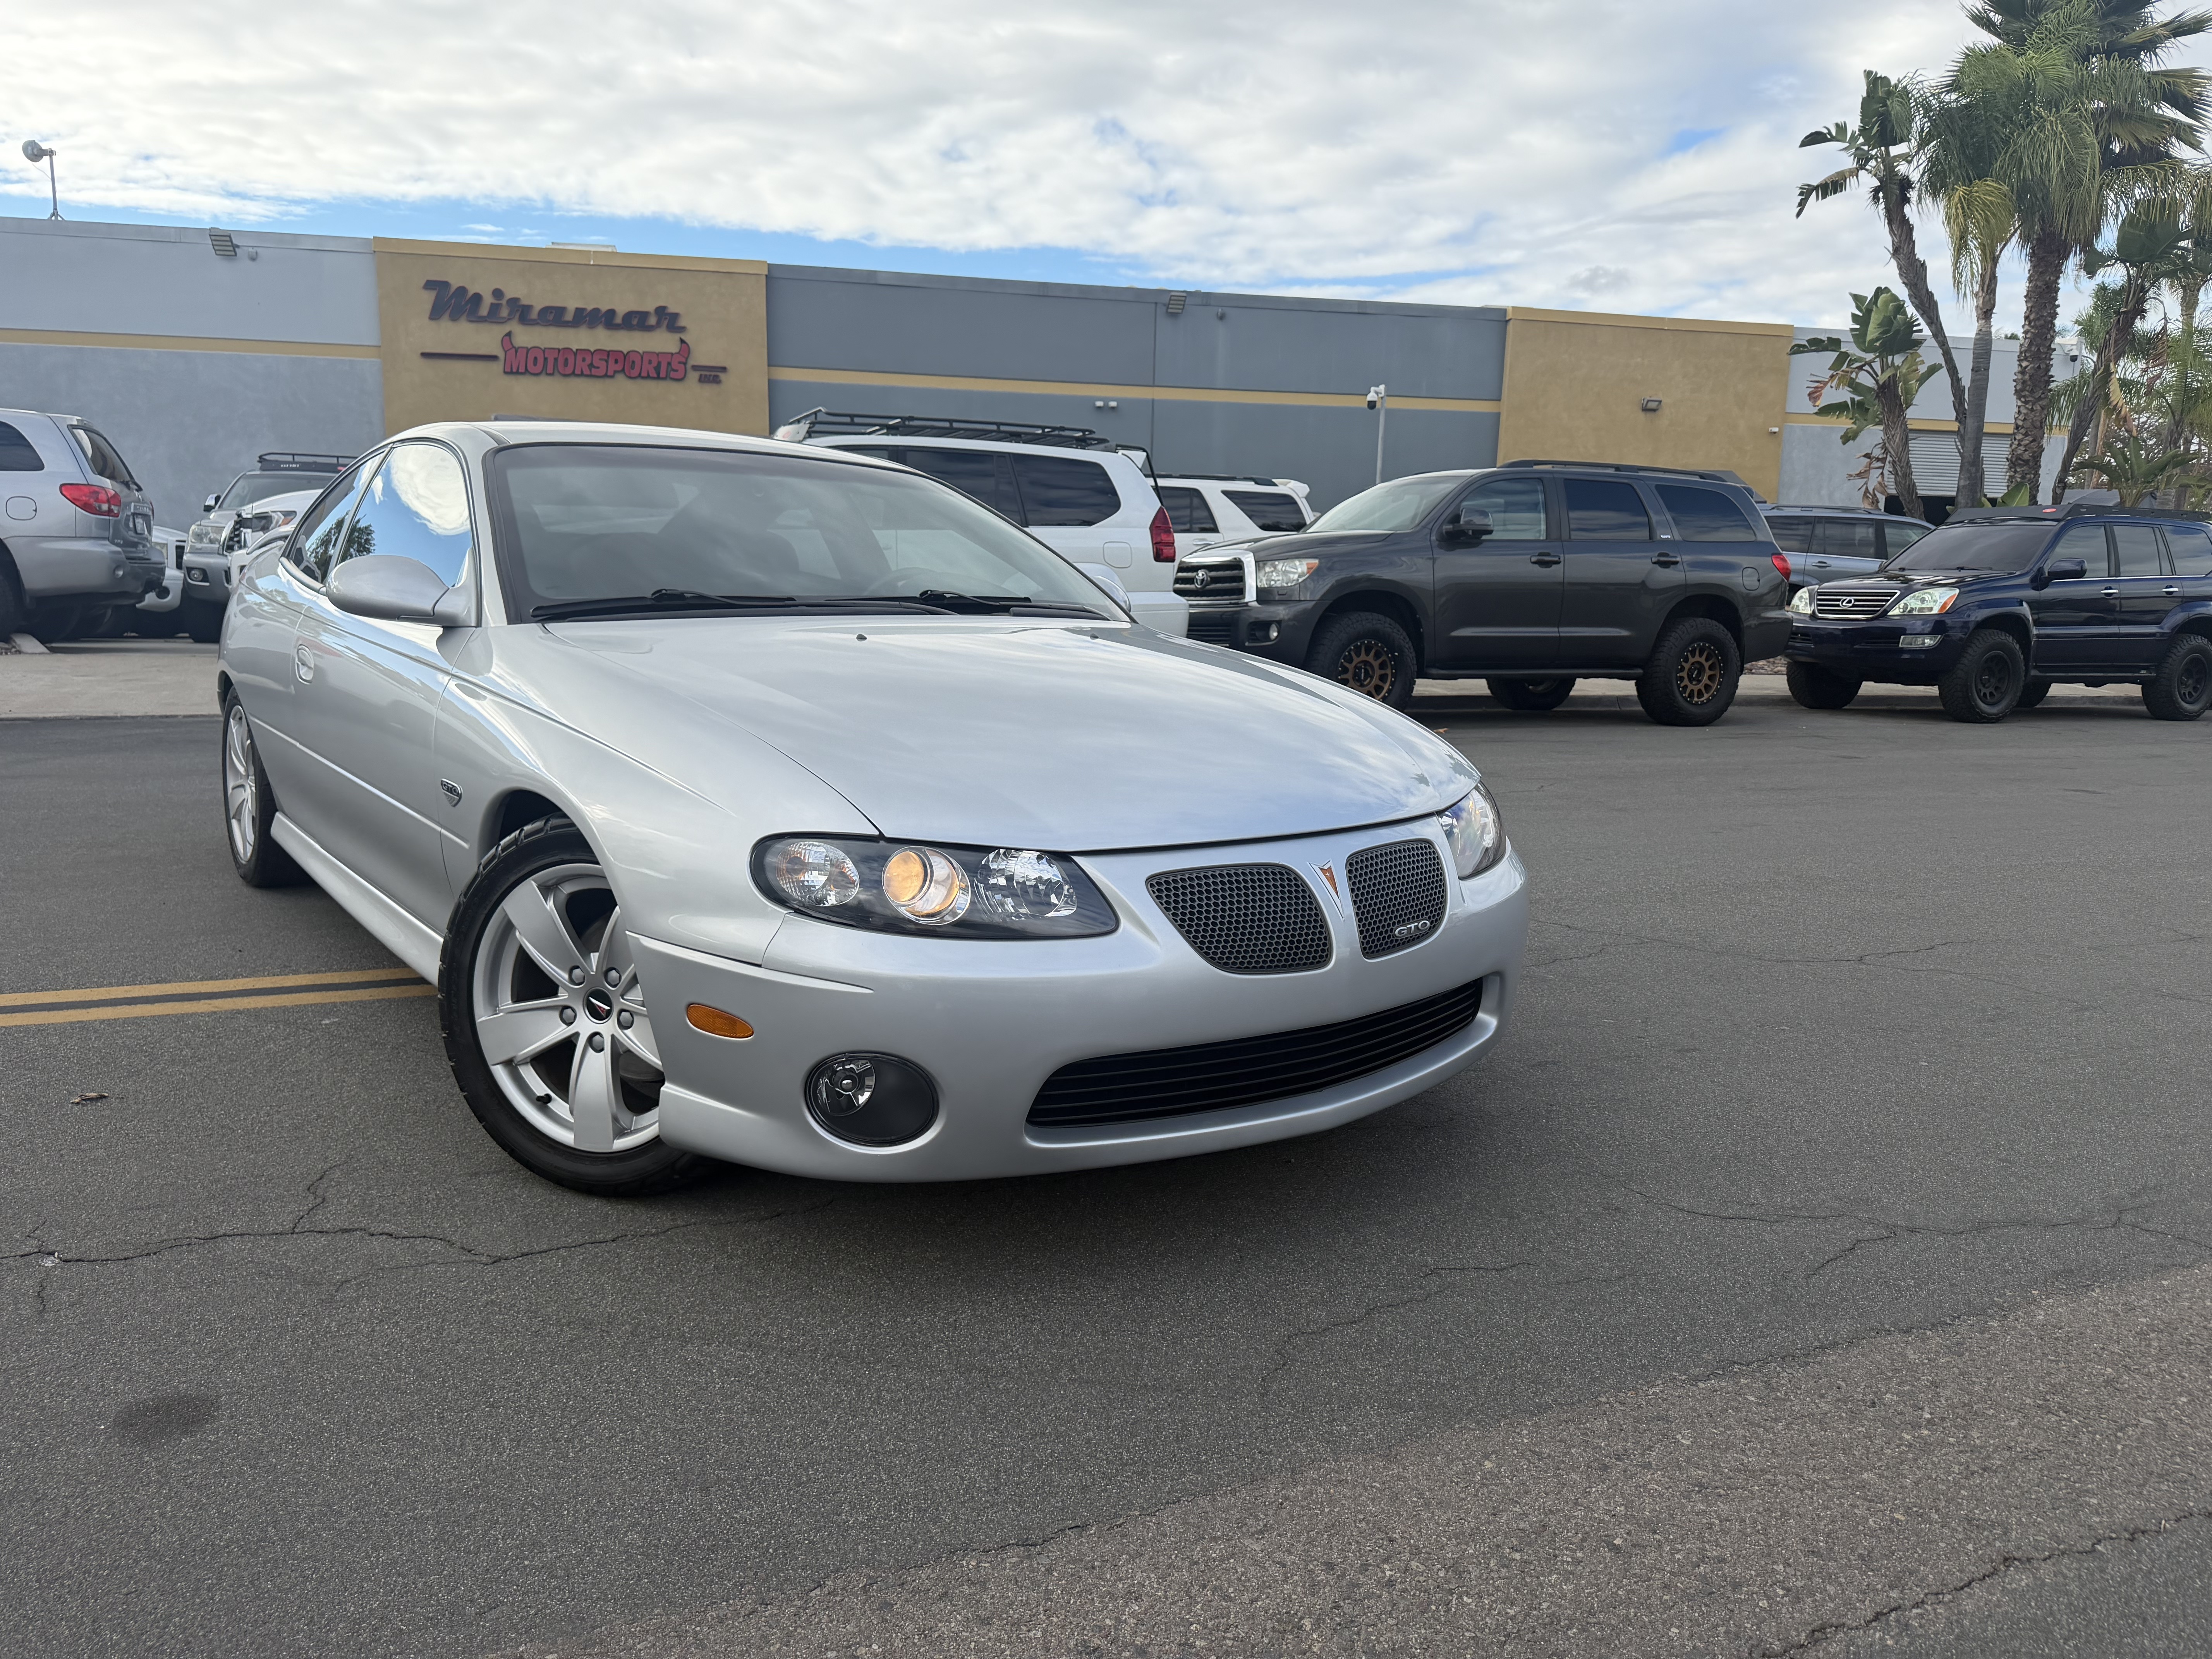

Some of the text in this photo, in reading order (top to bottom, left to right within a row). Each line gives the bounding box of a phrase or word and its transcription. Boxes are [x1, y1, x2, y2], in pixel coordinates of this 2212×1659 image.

[422, 279, 687, 332] Miramar
[503, 346, 688, 381] MOTORSPORTS
[443, 782, 458, 795] GTO
[1395, 920, 1431, 937] GTO
